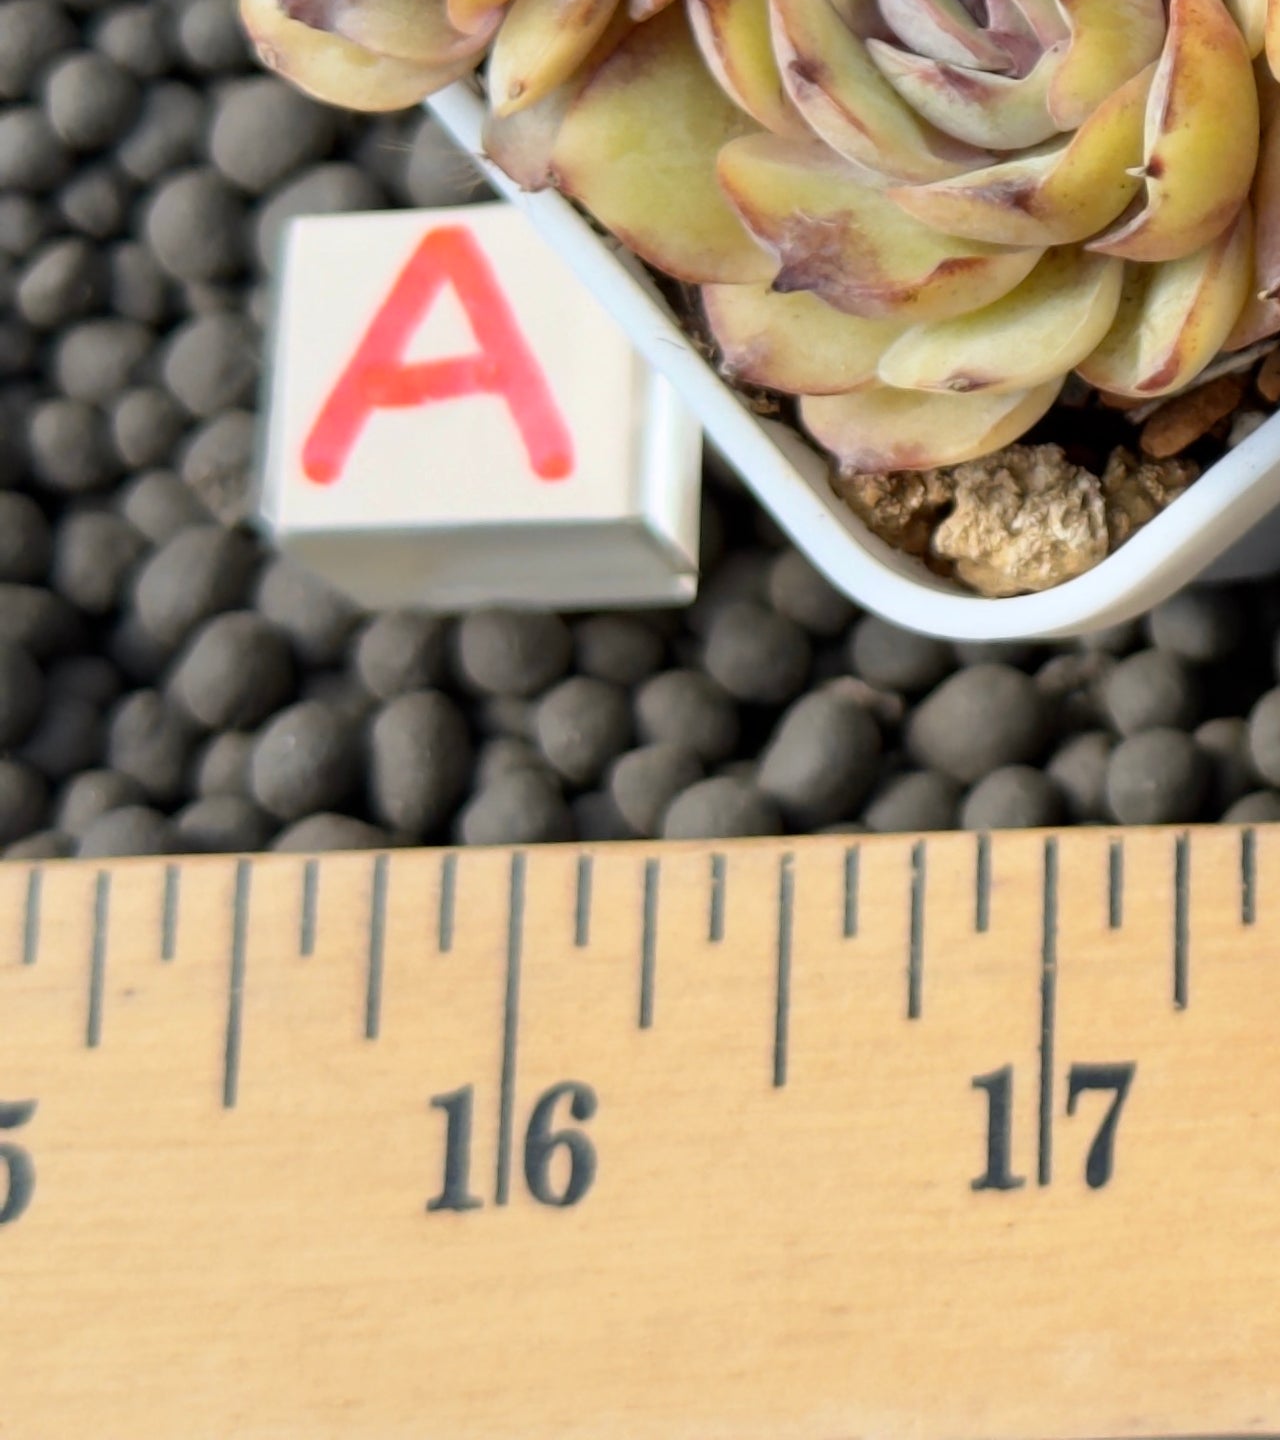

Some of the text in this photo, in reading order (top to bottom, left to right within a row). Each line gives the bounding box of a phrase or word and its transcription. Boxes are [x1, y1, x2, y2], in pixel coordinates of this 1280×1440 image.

[301, 224, 575, 485] A
[426, 1080, 598, 1213] 16
[970, 1060, 1136, 1192] 17
